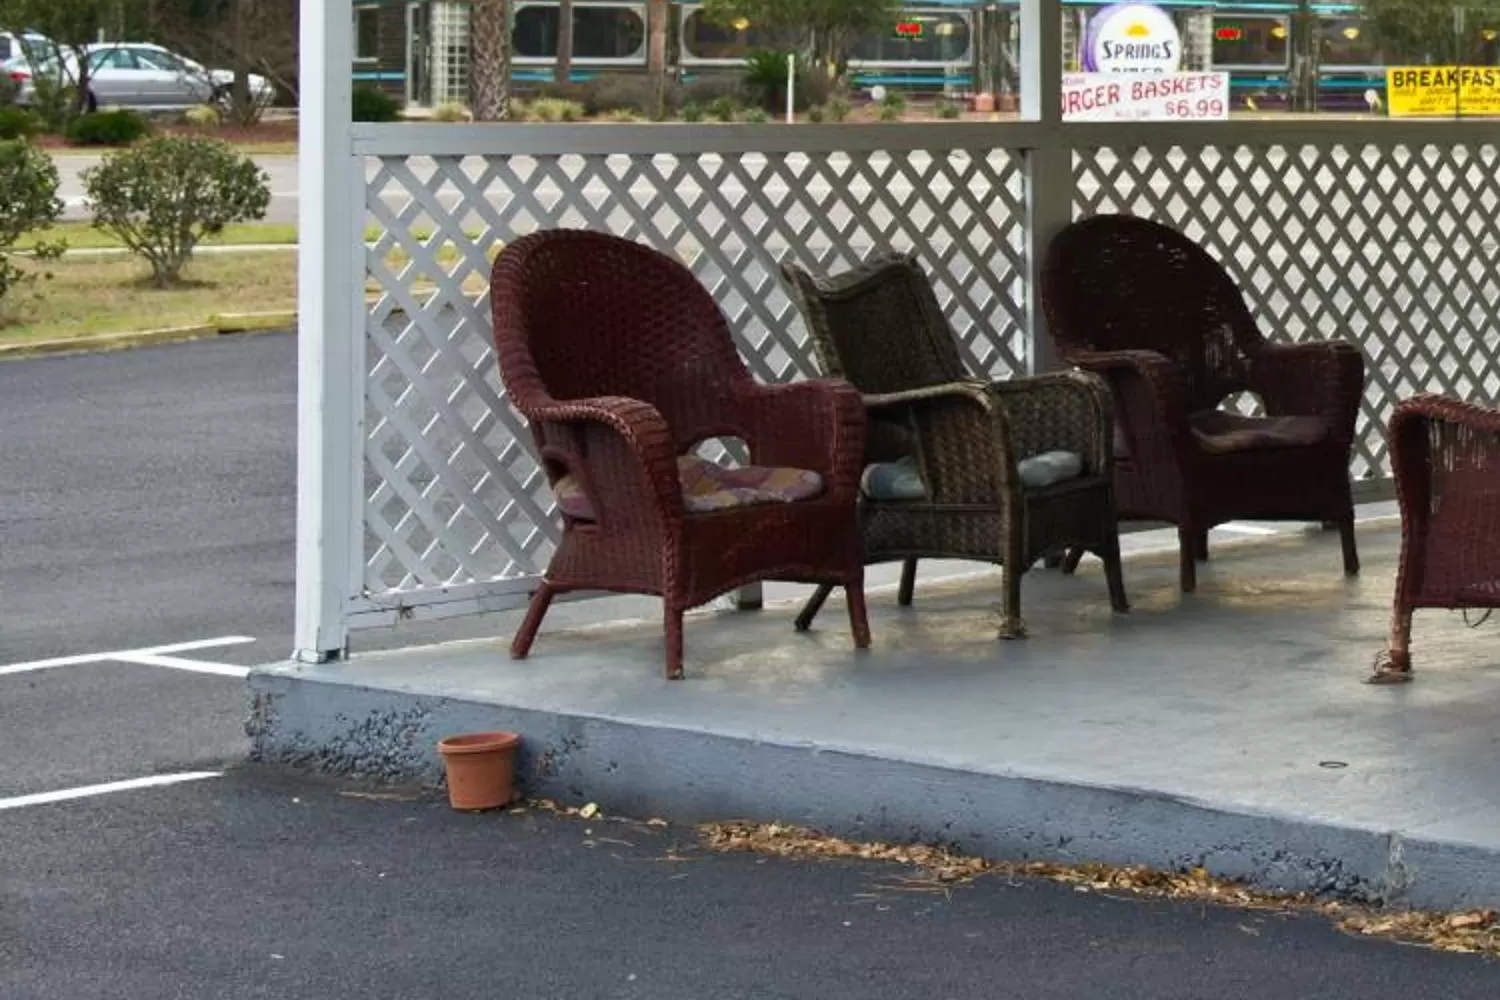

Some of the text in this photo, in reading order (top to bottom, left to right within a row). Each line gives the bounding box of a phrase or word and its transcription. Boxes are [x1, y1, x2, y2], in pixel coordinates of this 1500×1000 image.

[1102, 40, 1174, 60] SPRINGS
[1131, 74, 1223, 101] BASKETS
[1164, 99, 1224, 118] $6.99
